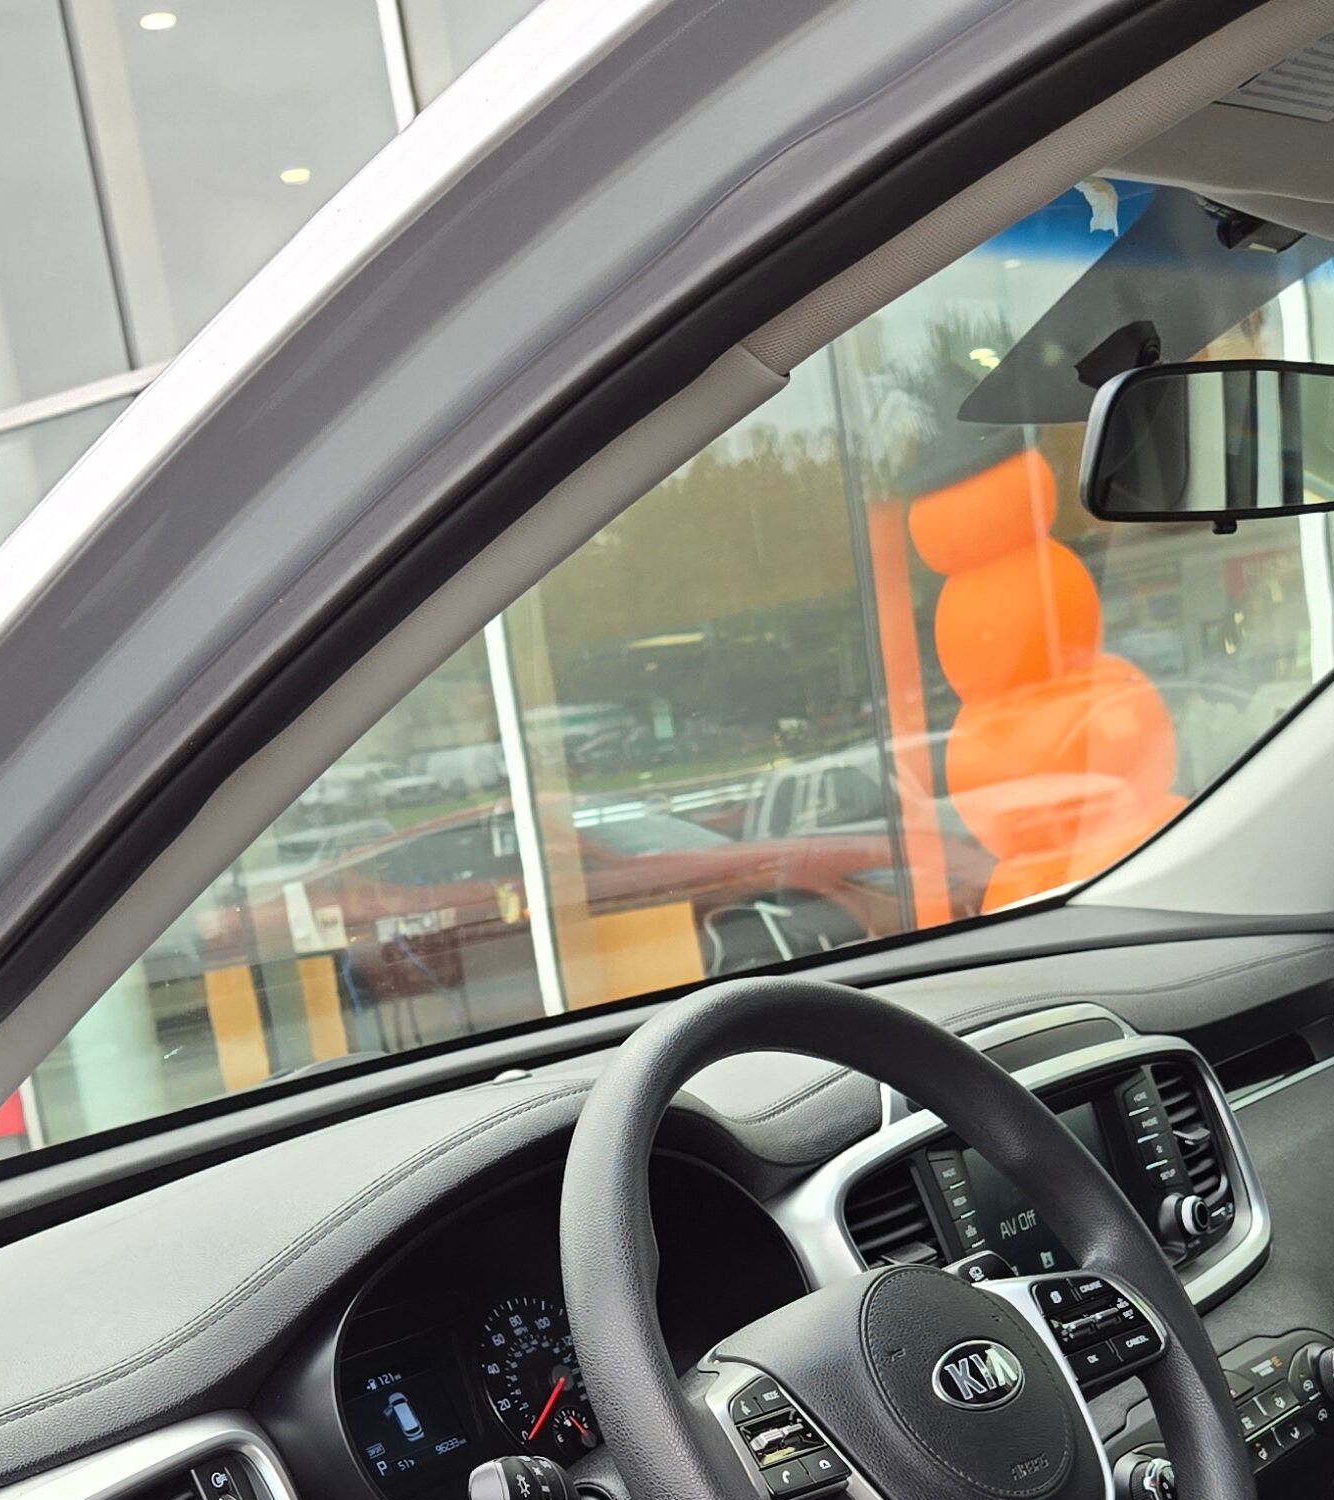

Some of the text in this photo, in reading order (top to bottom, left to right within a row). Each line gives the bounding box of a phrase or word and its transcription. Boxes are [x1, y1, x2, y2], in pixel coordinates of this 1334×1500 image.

[999, 1217, 1018, 1240] AV
[1017, 1208, 1038, 1231] Off
[509, 1314, 523, 1328] 80
[534, 1316, 551, 1331] 100
[491, 1333, 506, 1347] 60
[487, 1363, 501, 1375] 40
[944, 1347, 1018, 1401] KIA
[497, 1398, 511, 1411] 20
[376, 1460, 388, 1476] P
